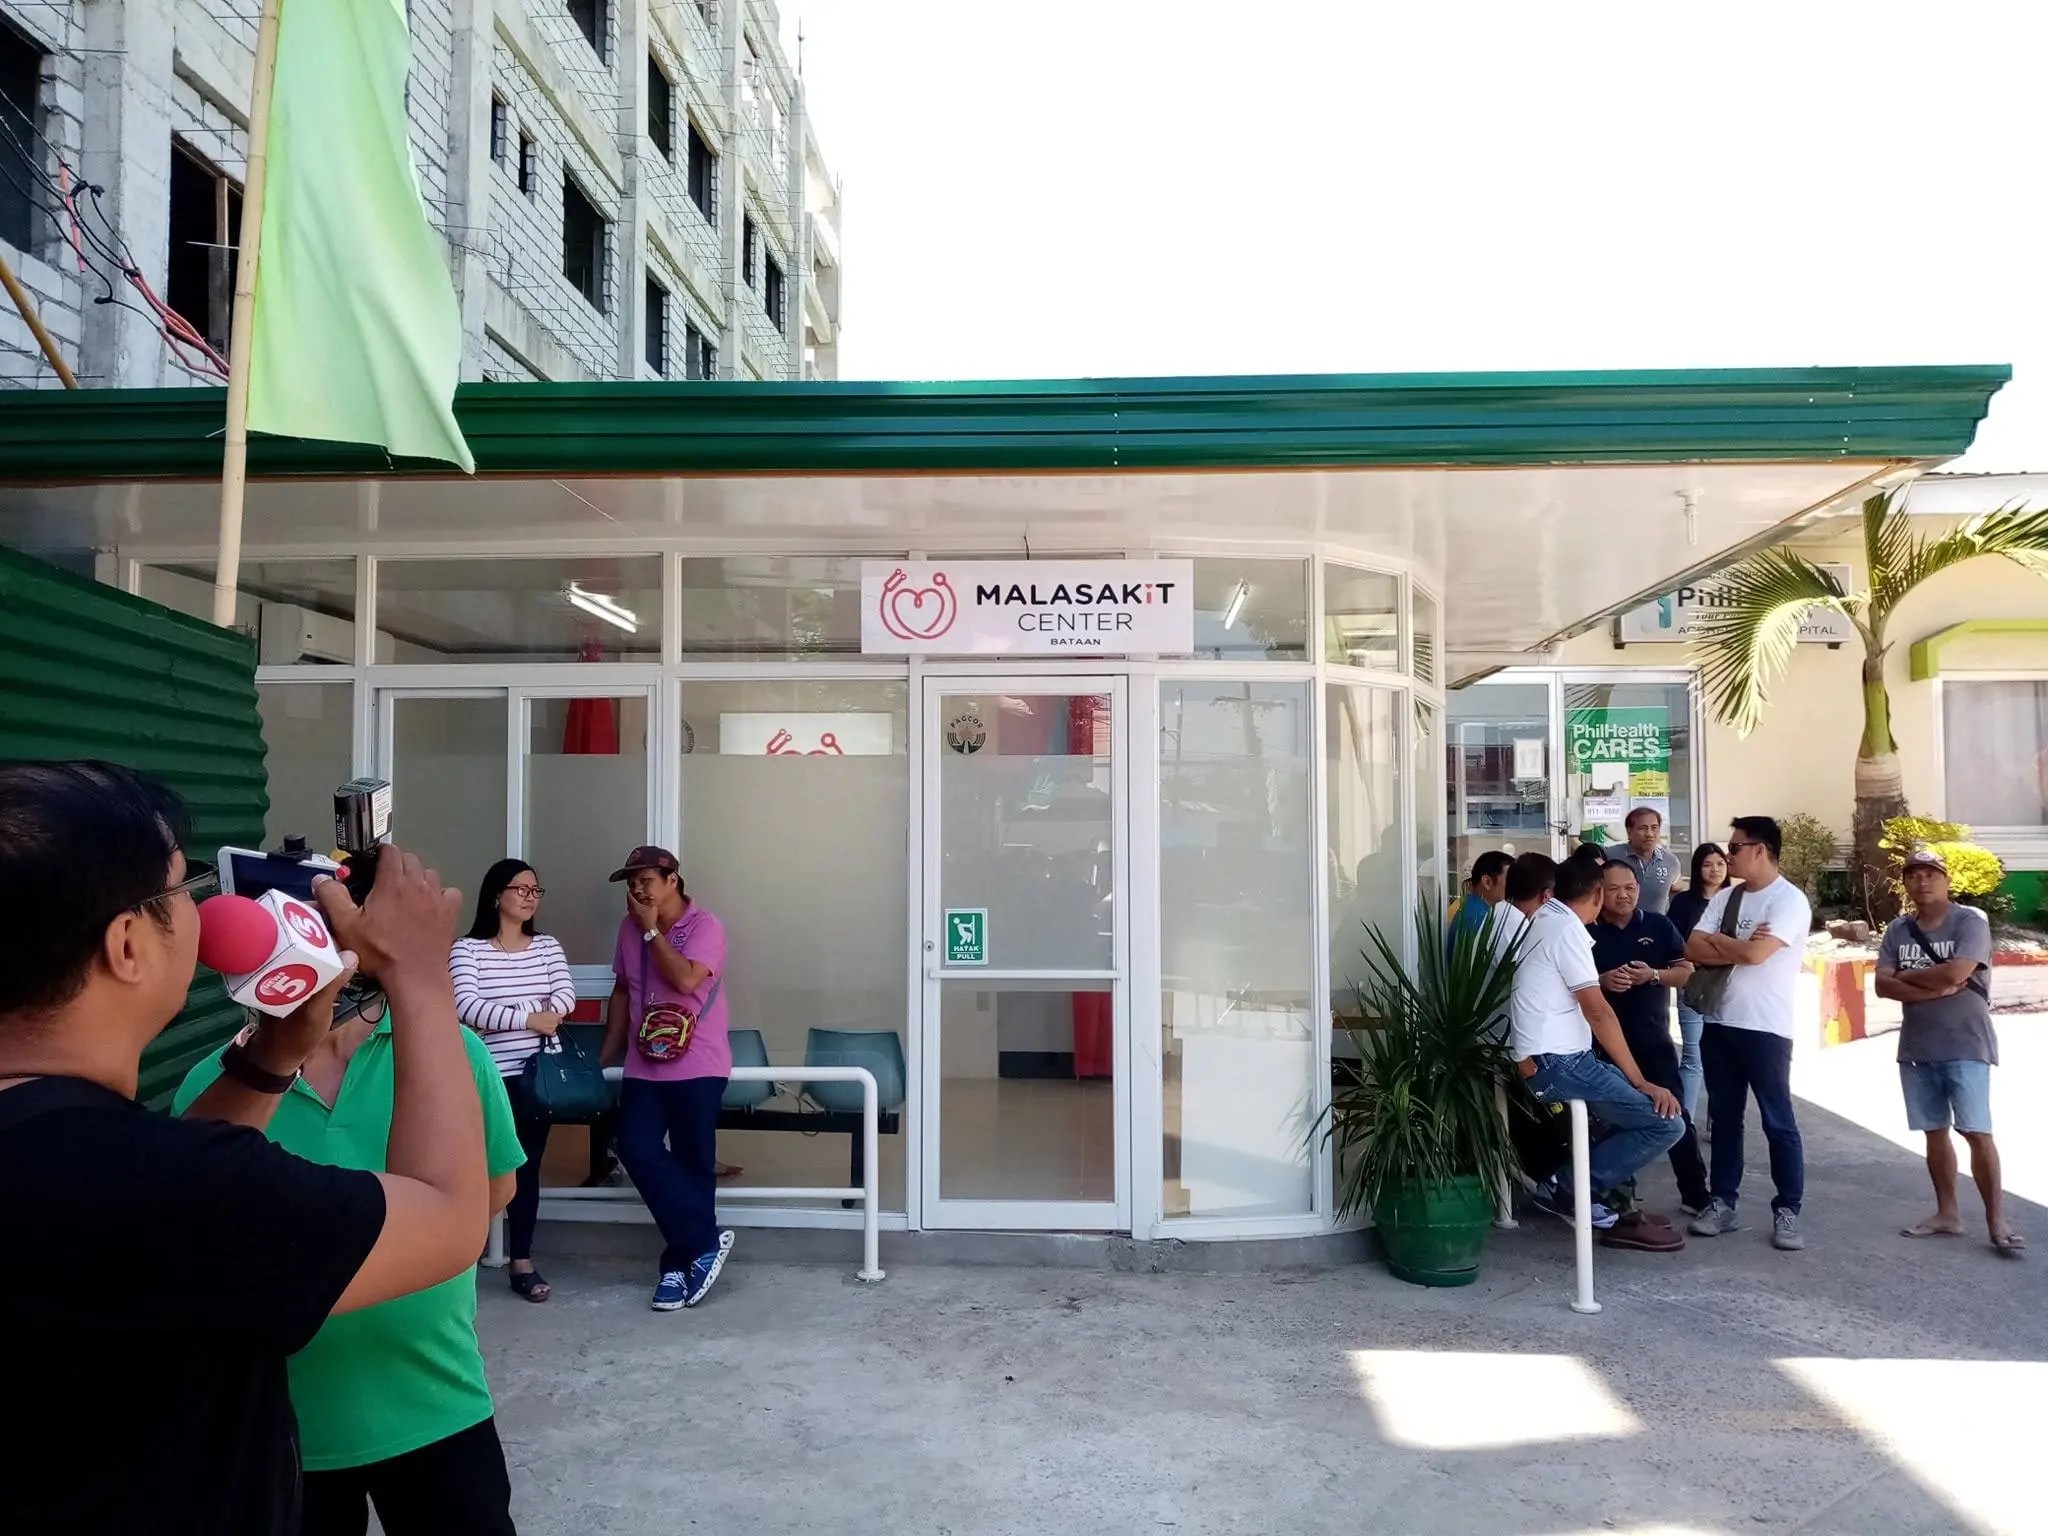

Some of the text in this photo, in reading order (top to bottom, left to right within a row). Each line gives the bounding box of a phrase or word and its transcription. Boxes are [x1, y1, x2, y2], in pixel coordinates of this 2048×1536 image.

[1018, 612, 1134, 632] CENTER
[1050, 637, 1102, 647] BATAAN
[1573, 722, 1660, 738] PhilHealth
[1573, 737, 1661, 760] CARES
[1656, 867, 1668, 876] 33
[272, 975, 307, 999] 5
